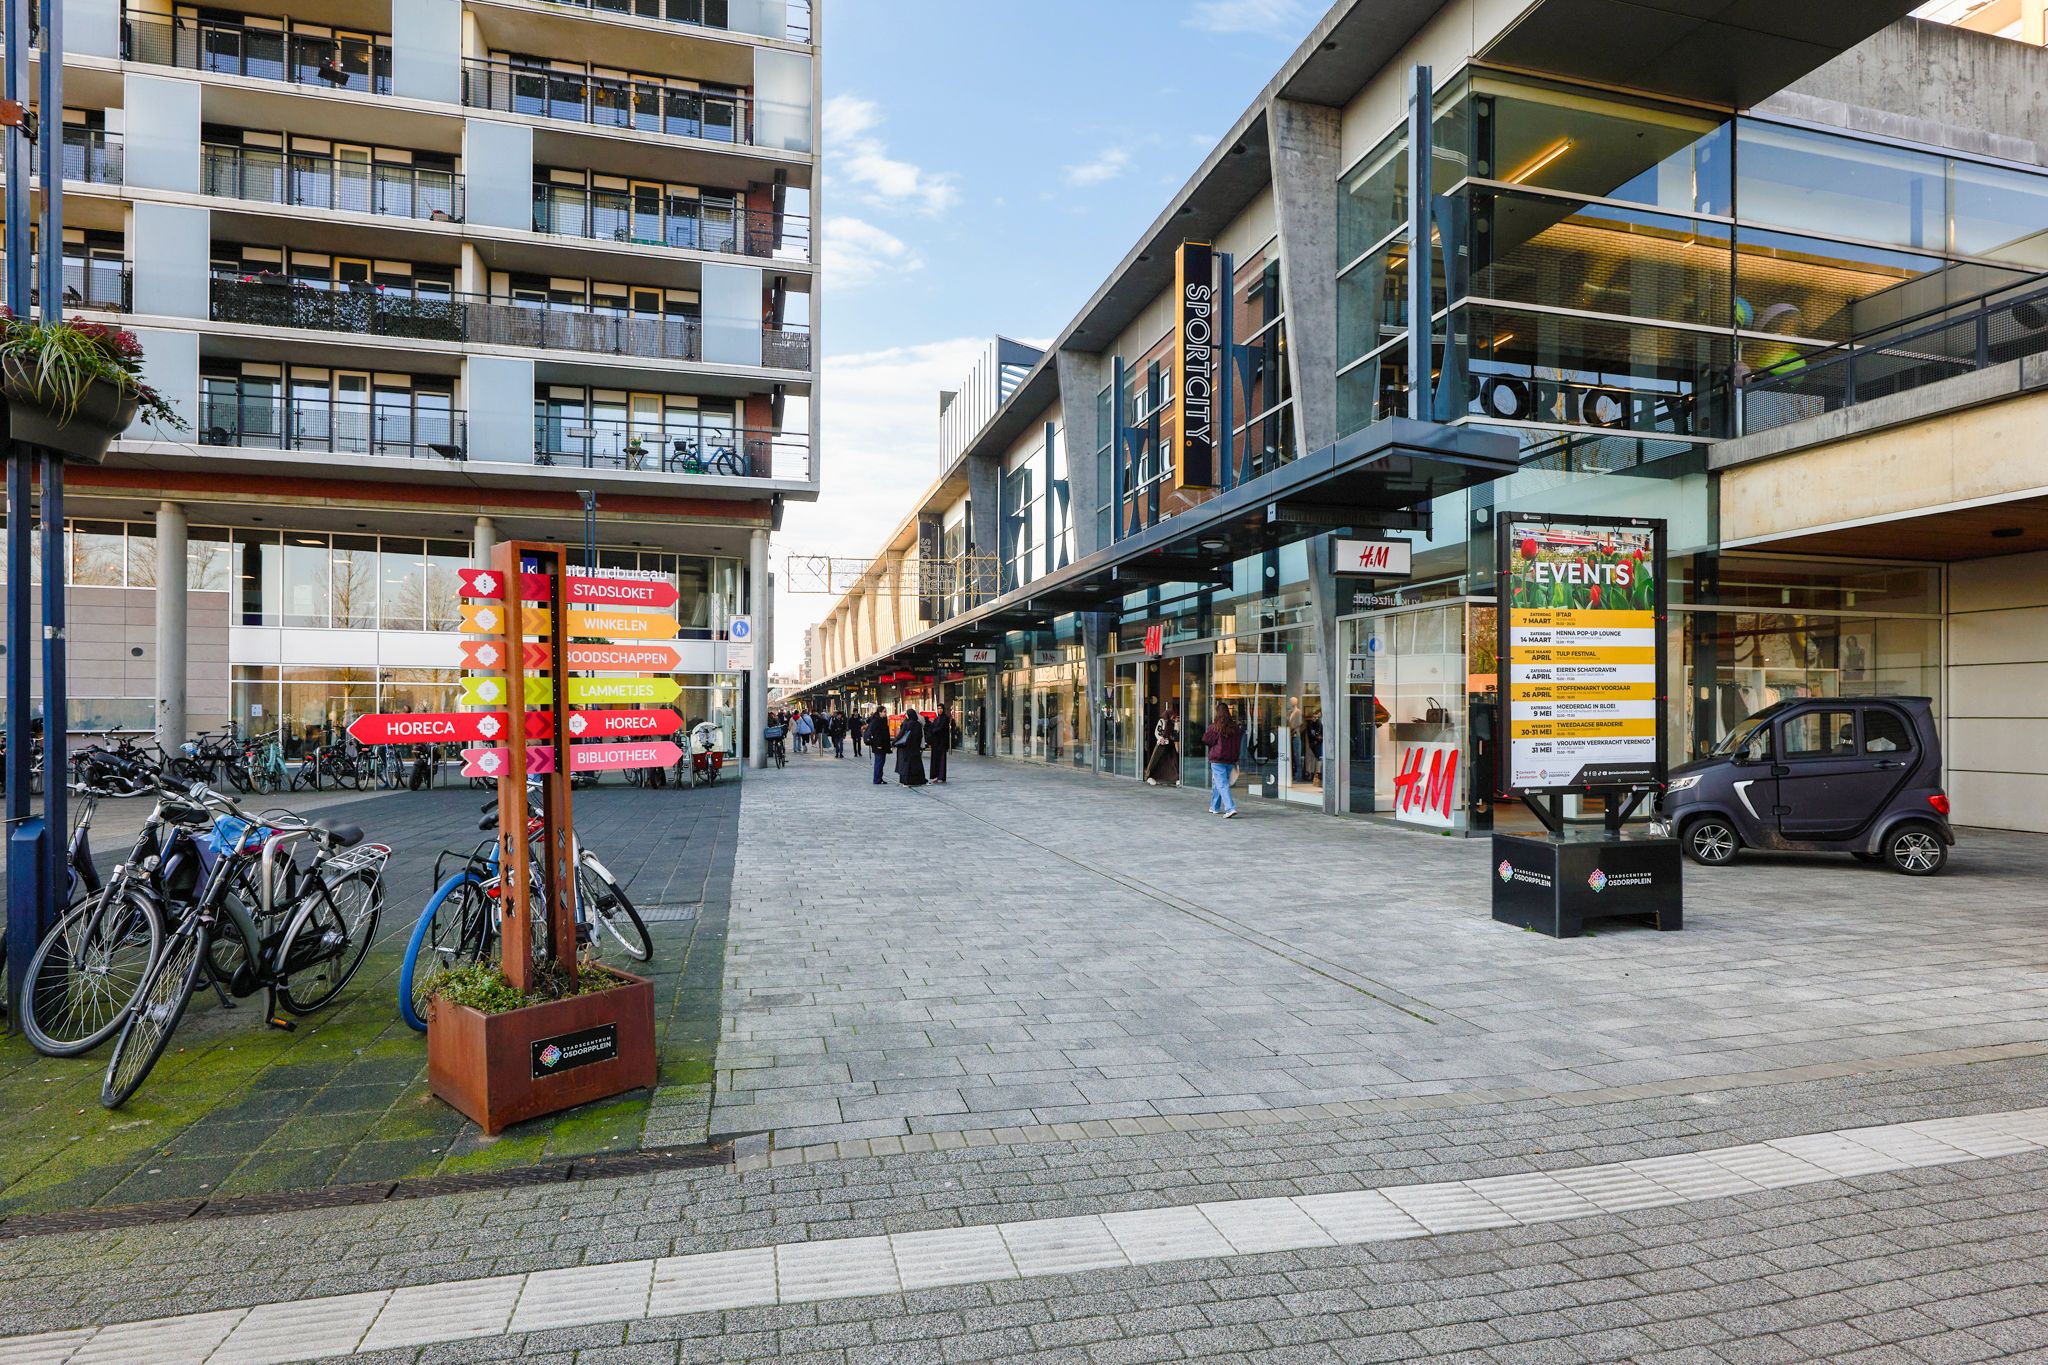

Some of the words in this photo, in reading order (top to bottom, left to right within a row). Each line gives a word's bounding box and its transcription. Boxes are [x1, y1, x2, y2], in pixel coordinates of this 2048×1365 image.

[1359, 545, 1390, 569] H&M
[1535, 562, 1630, 586] EVENTS
[573, 583, 655, 600] STADSLOKET
[584, 618, 648, 631] WINKELEN
[567, 650, 668, 665] BOODSCHAPPEN
[579, 685, 654, 697] LAMMETJES
[387, 721, 456, 736] HORECA
[605, 717, 657, 729] HORECA
[577, 749, 657, 764] BIBLIOTHEEK
[1393, 747, 1459, 820] H&M
[1513, 867, 1552, 880] STADSCENTRUM
[1513, 873, 1551, 888] OSDORPPLEIN
[1608, 877, 1652, 887] OSDORPPLEIN
[562, 1036, 612, 1051] STADSCENTRUM
[562, 1041, 612, 1059] OSDORPPLEIN
